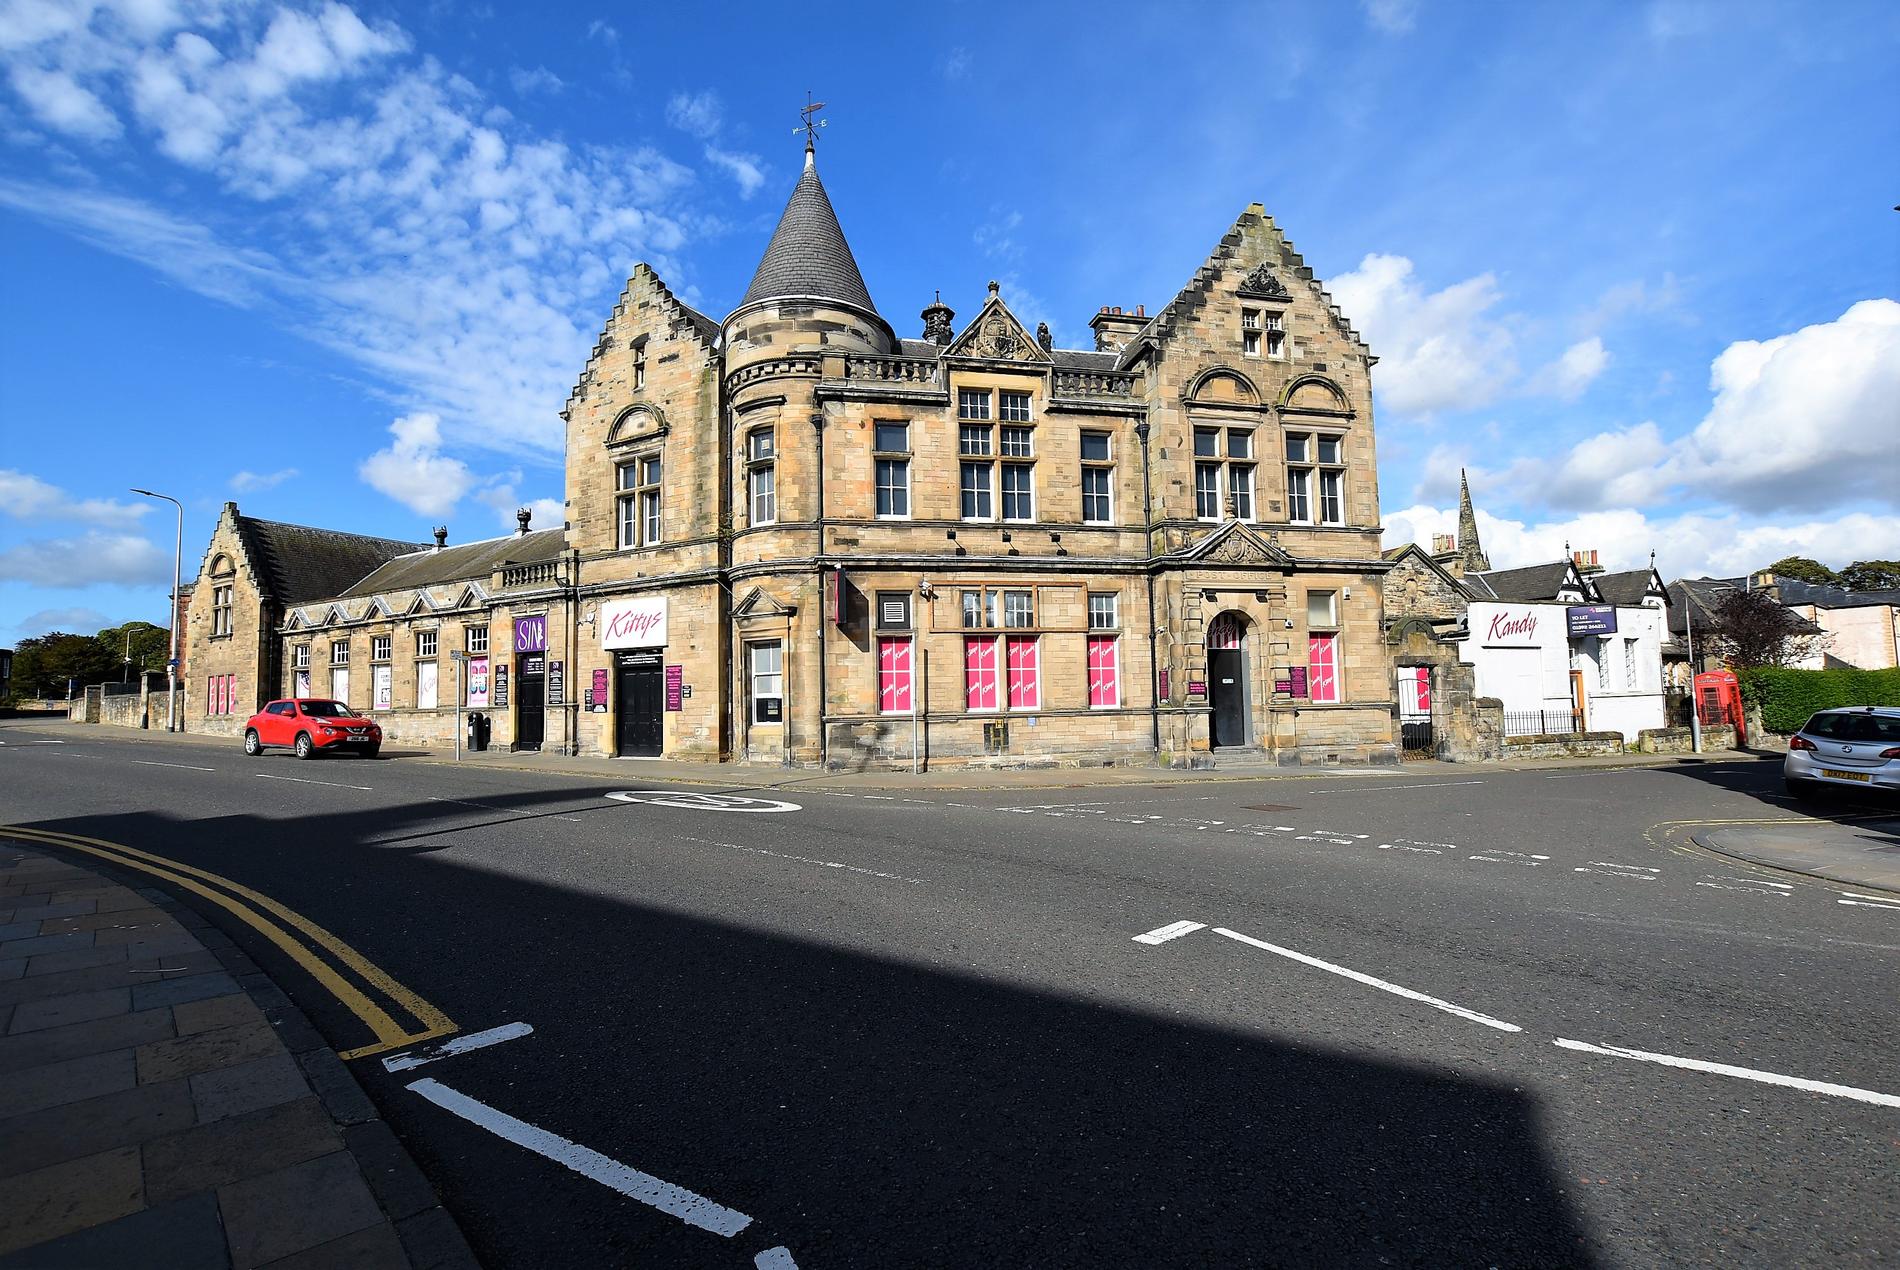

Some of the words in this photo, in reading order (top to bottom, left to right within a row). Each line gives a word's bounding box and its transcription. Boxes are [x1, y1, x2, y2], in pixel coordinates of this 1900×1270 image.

[1196, 571, 1226, 579] POST
[1234, 572, 1272, 580] OFFICE
[517, 620, 544, 650] SIN
[605, 610, 662, 640] Kittys
[1488, 611, 1538, 641] Kandy
